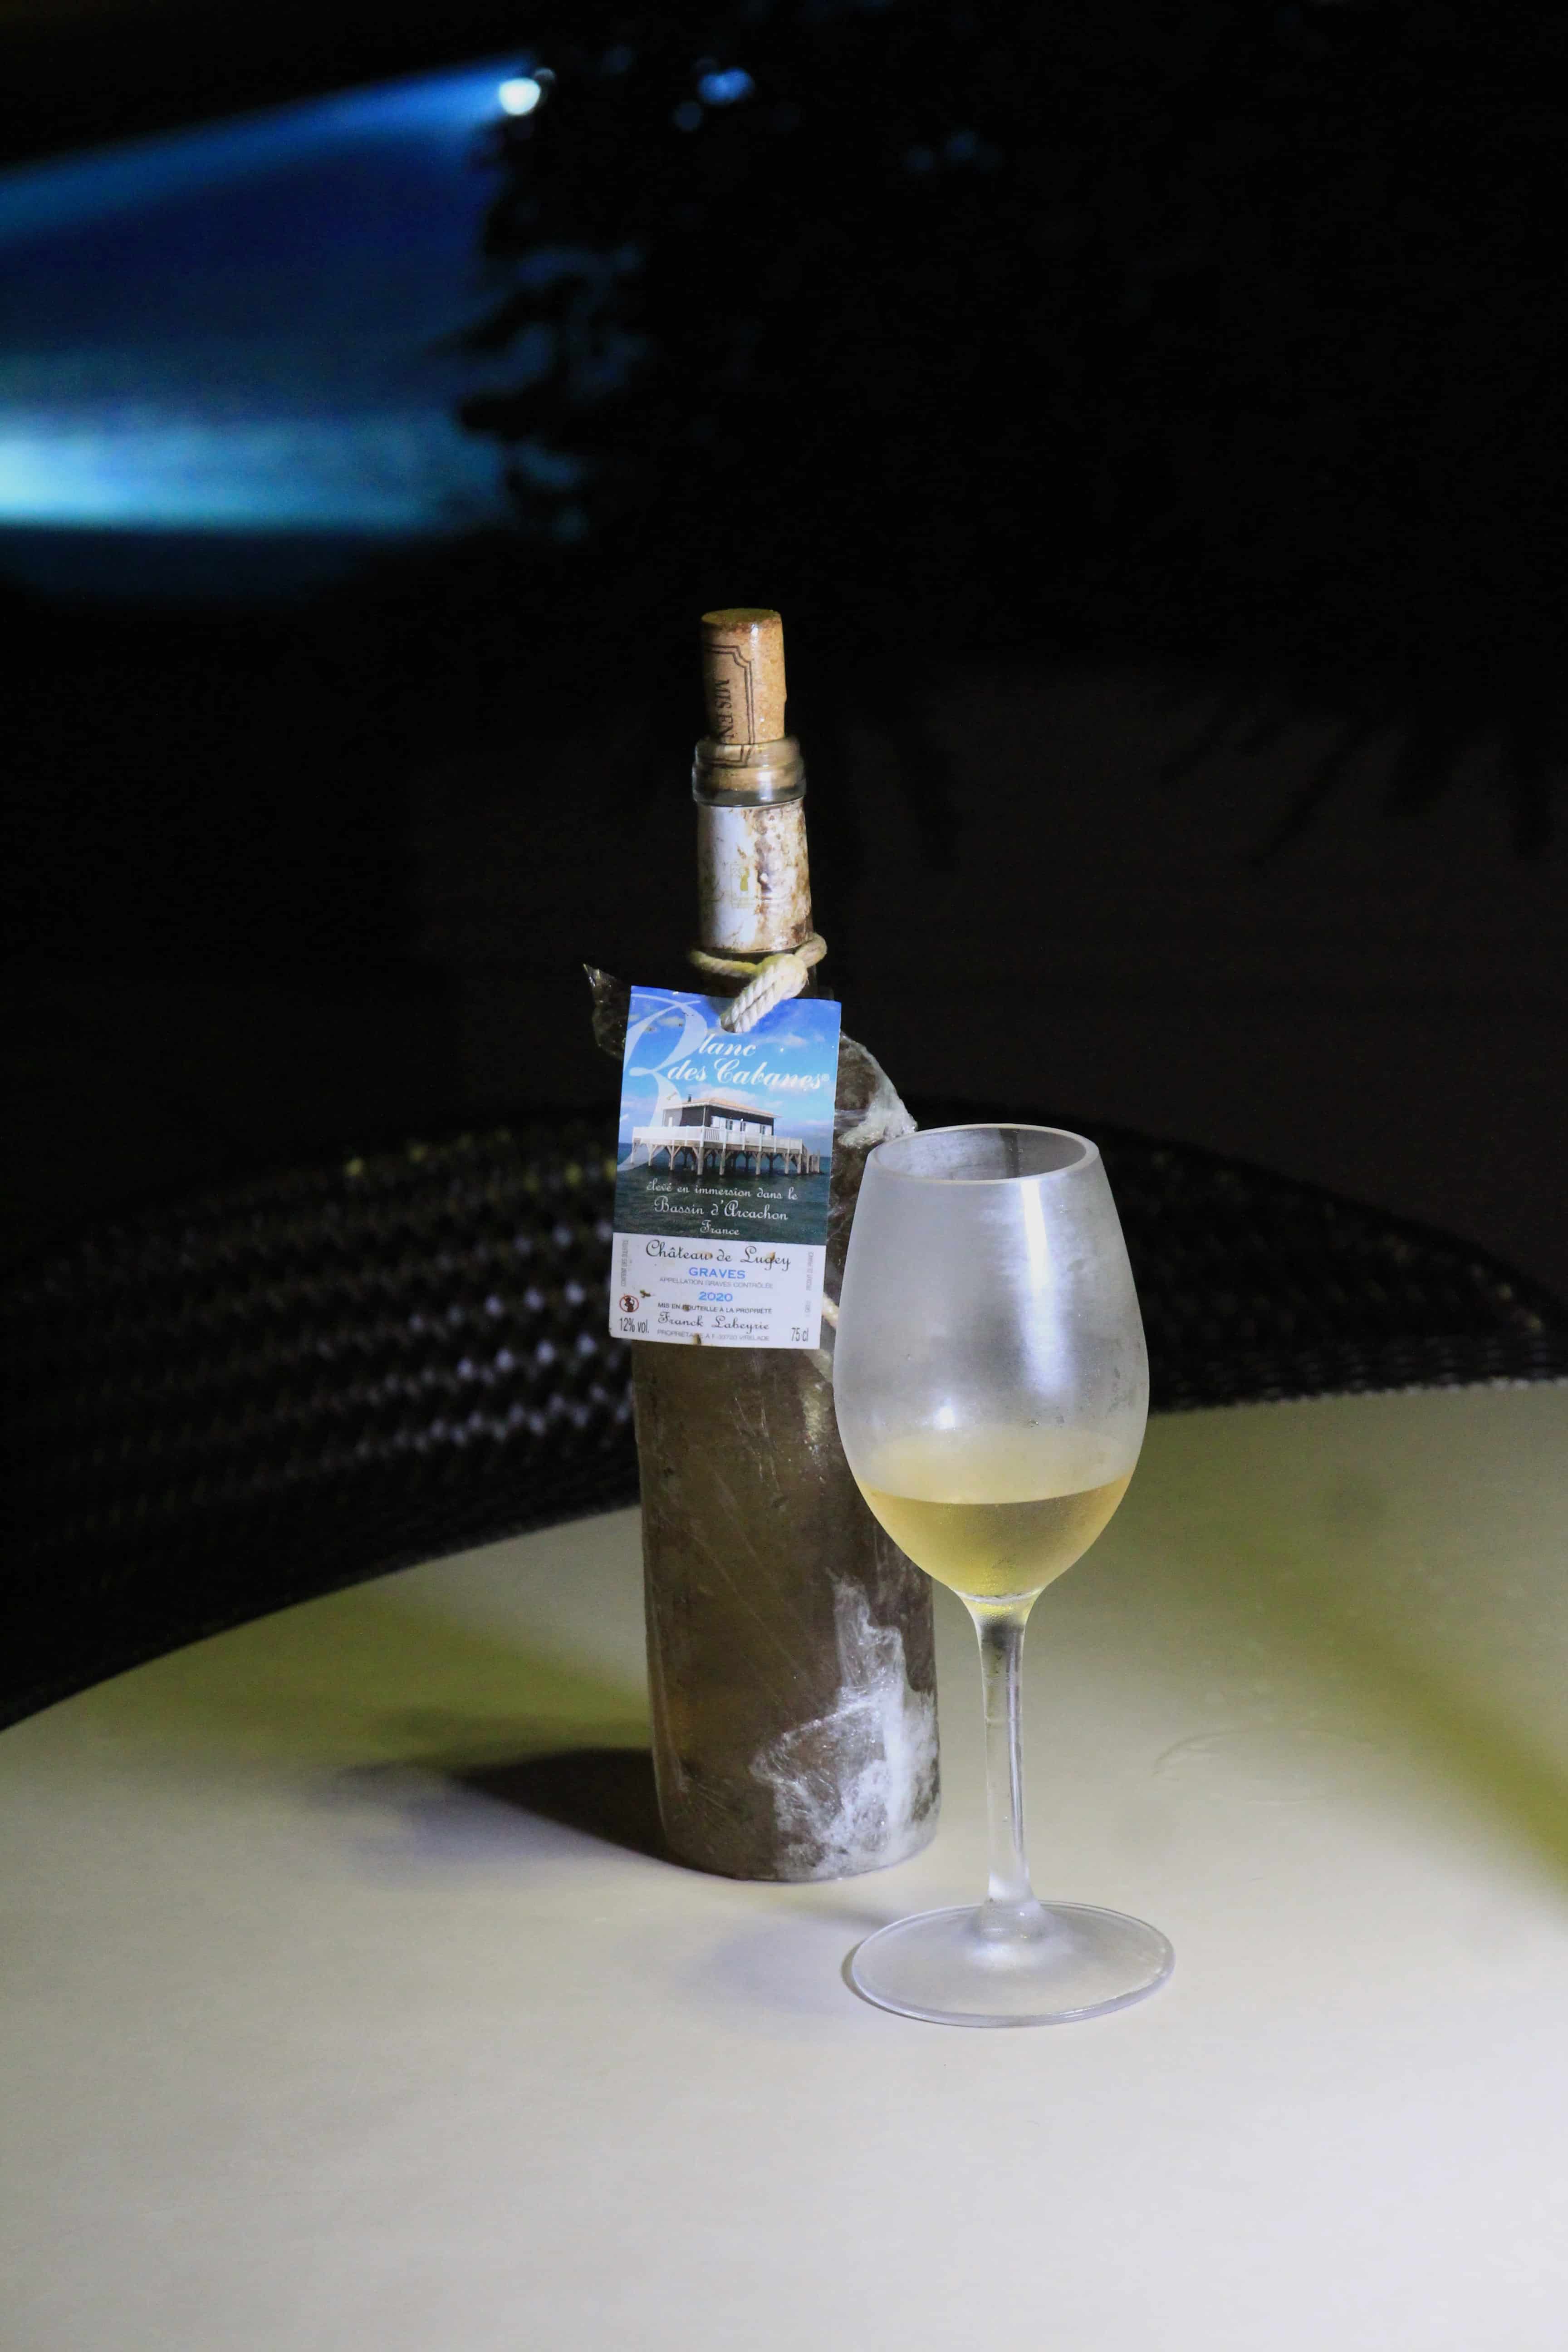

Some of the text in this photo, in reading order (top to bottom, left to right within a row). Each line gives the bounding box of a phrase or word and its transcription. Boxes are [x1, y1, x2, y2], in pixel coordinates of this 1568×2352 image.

[714, 679, 732, 709] MIS
[667, 1058, 821, 1089] des Cabanes
[695, 1185, 751, 1198] immersion
[756, 1187, 783, 1199] dans
[788, 1186, 799, 1200] le
[654, 1195, 788, 1220] Bassin d'Arcachon
[700, 1219, 740, 1235] France
[646, 1239, 791, 1271] Château de Lugey
[659, 1277, 703, 1285] APPELLATION
[688, 1267, 746, 1279] GRAVES
[698, 1291, 733, 1302] 2020
[619, 1317, 650, 1333] 12% vol.
[658, 1311, 770, 1334] Franck Labeyrie
[791, 1328, 809, 1342] 75 cl
